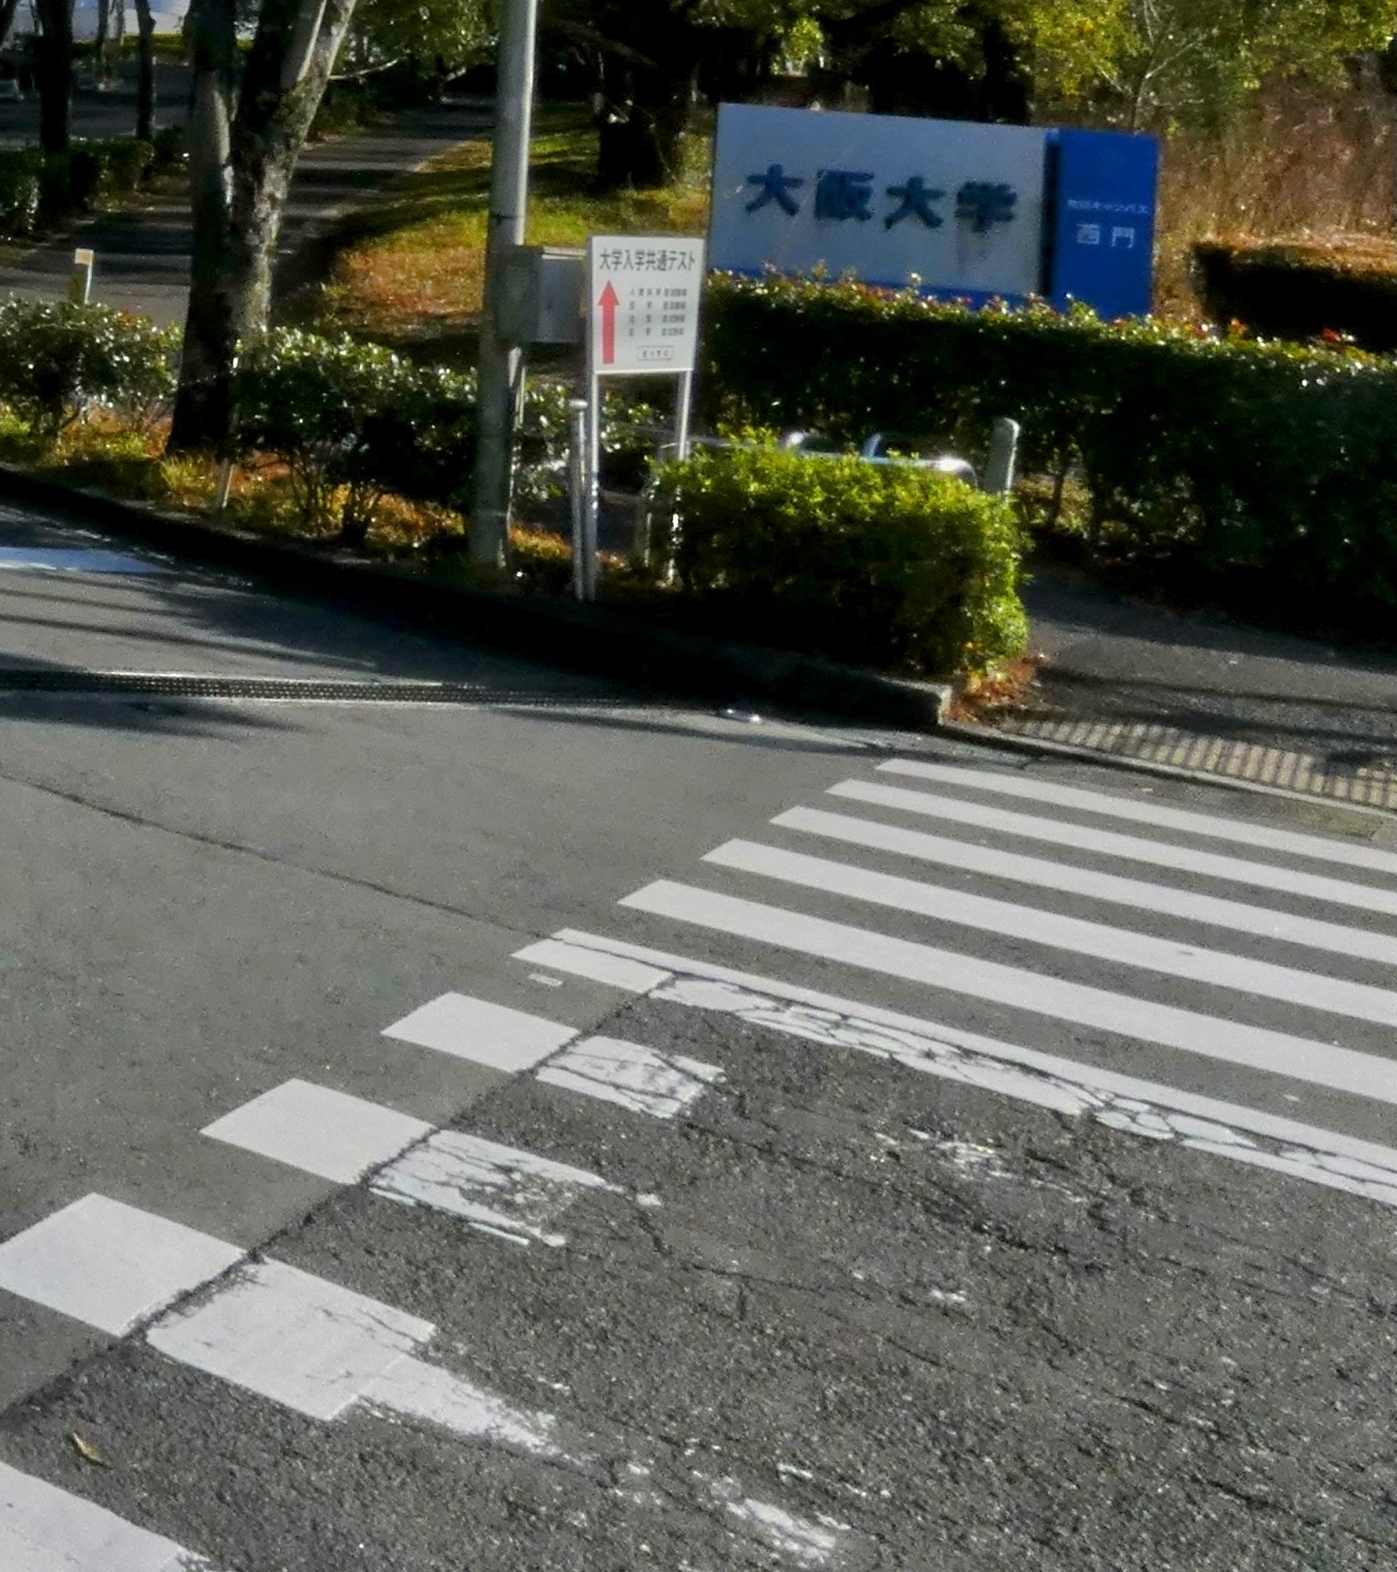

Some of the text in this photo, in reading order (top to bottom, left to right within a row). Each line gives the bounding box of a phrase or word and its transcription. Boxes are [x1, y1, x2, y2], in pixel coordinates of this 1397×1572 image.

[745, 163, 1019, 232] 大阪大学
[599, 247, 696, 272] 大学入学共通テスト
